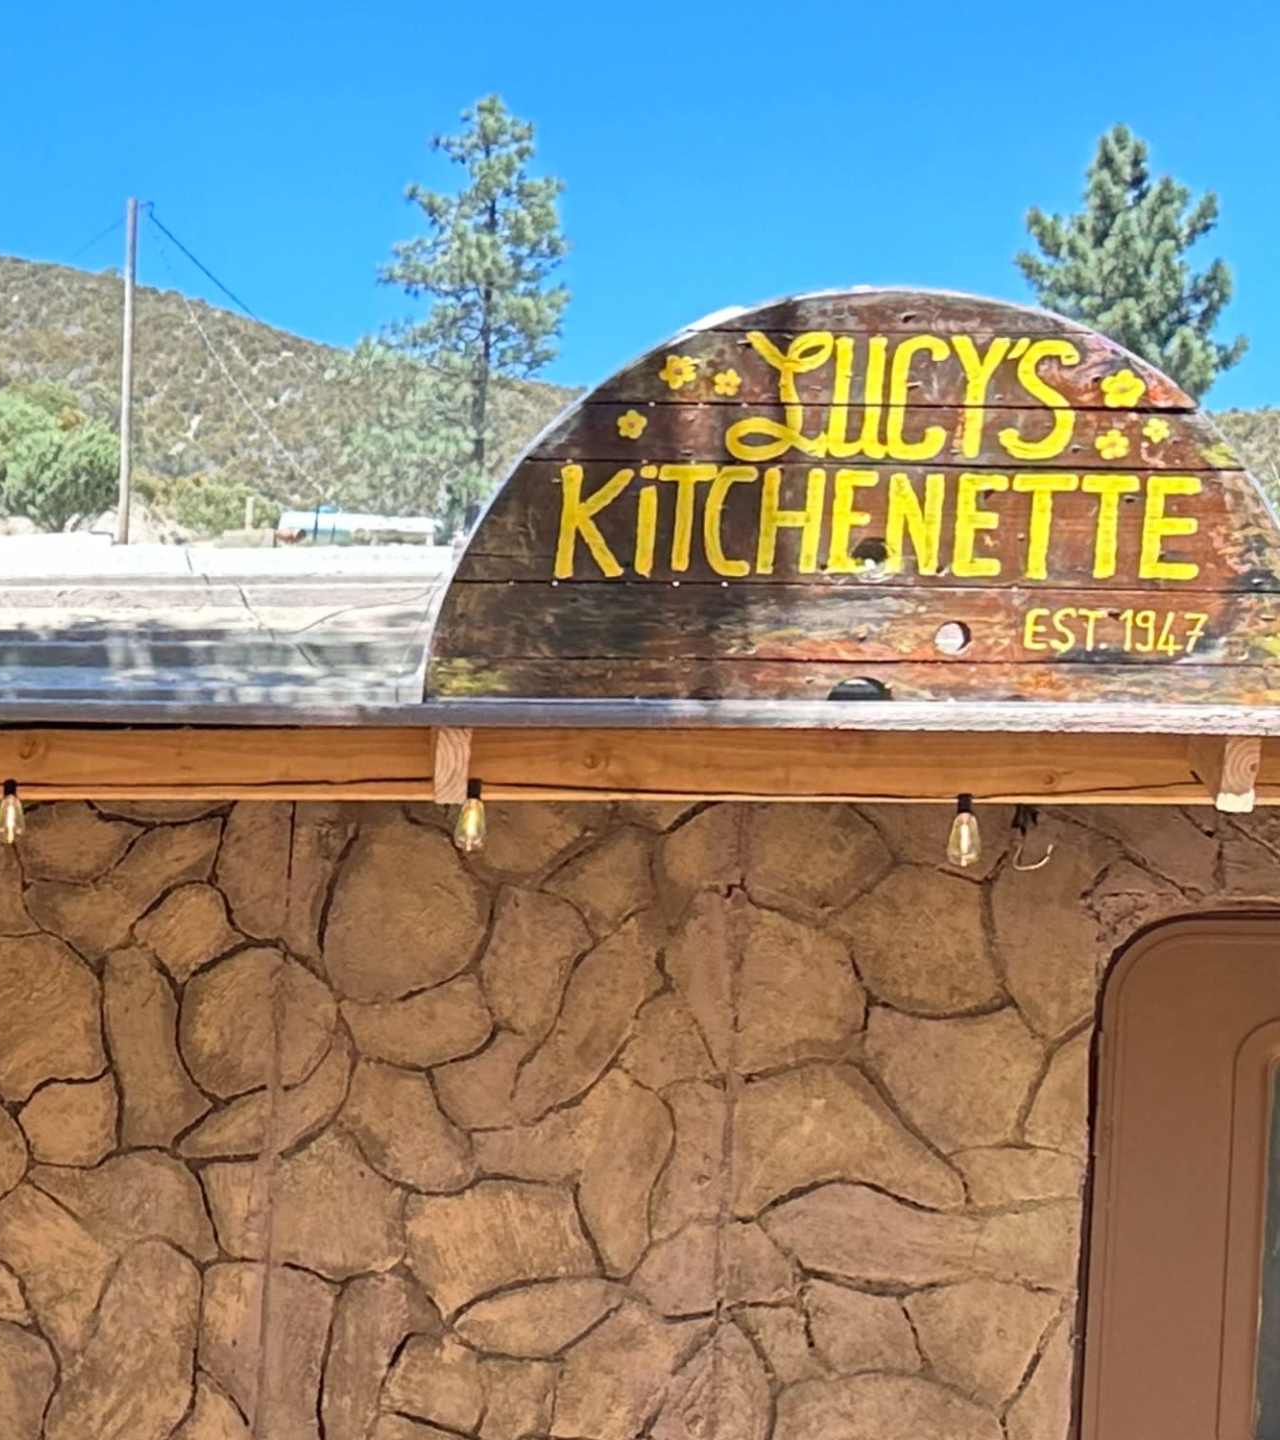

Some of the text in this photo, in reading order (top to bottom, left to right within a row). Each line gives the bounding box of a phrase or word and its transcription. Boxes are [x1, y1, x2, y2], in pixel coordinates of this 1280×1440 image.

[724, 329, 1081, 462] LUCY'S
[1022, 606, 1209, 656] EST. 1947
